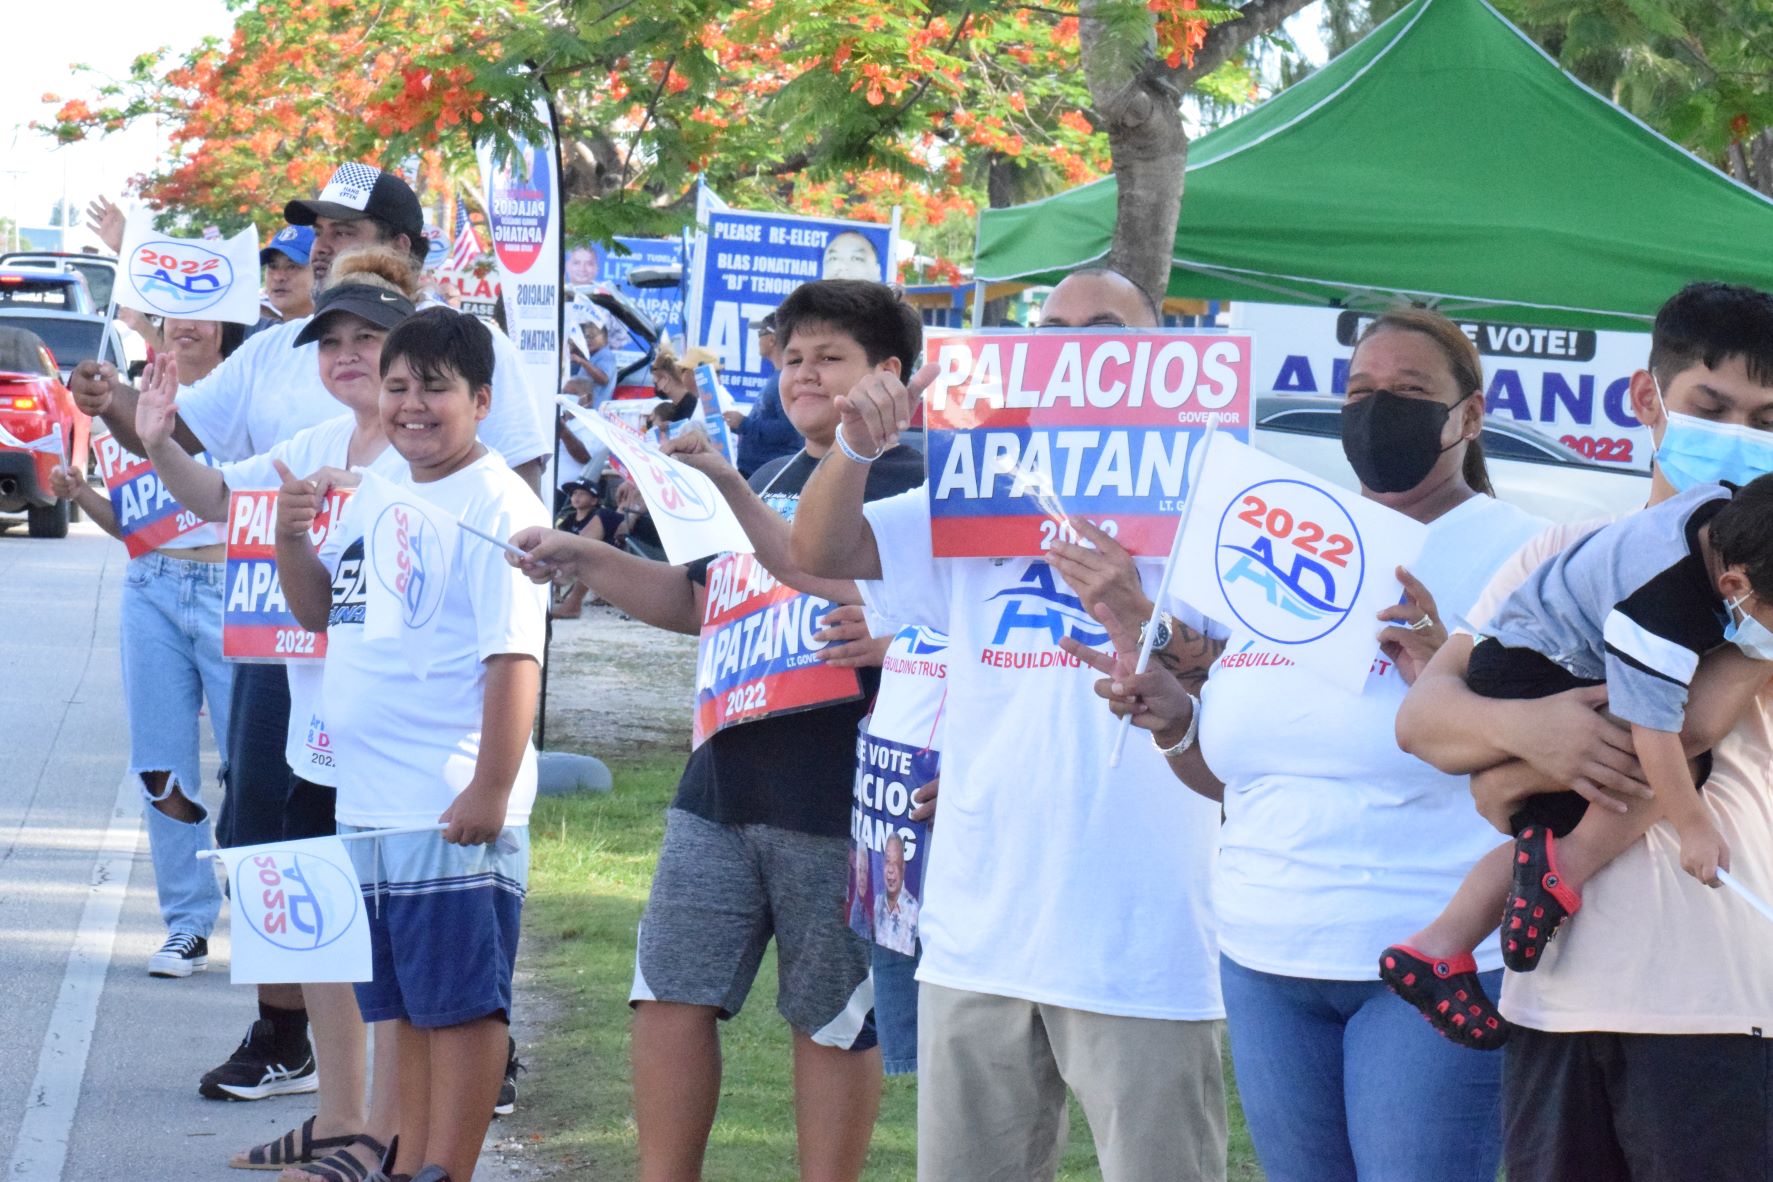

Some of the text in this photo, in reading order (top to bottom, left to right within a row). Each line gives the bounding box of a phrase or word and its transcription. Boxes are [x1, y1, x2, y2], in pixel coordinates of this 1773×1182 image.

[714, 221, 829, 248] PLEASE RE-ELECT
[140, 249, 220, 274] 2022
[717, 252, 818, 277] BLAS JONATHAN
[1486, 325, 1578, 356] VOTE!
[932, 340, 1241, 411] PALACIOS
[1178, 411, 1240, 423] GOVENOR
[1557, 434, 1633, 463] 2022
[176, 510, 204, 532] 20
[1237, 495, 1355, 569] 2022
[275, 630, 315, 653] 2022
[699, 595, 832, 693] APATANG
[981, 648, 1081, 669] REBUILDING
[725, 681, 767, 717] 2022
[868, 742, 913, 775] VOTE
